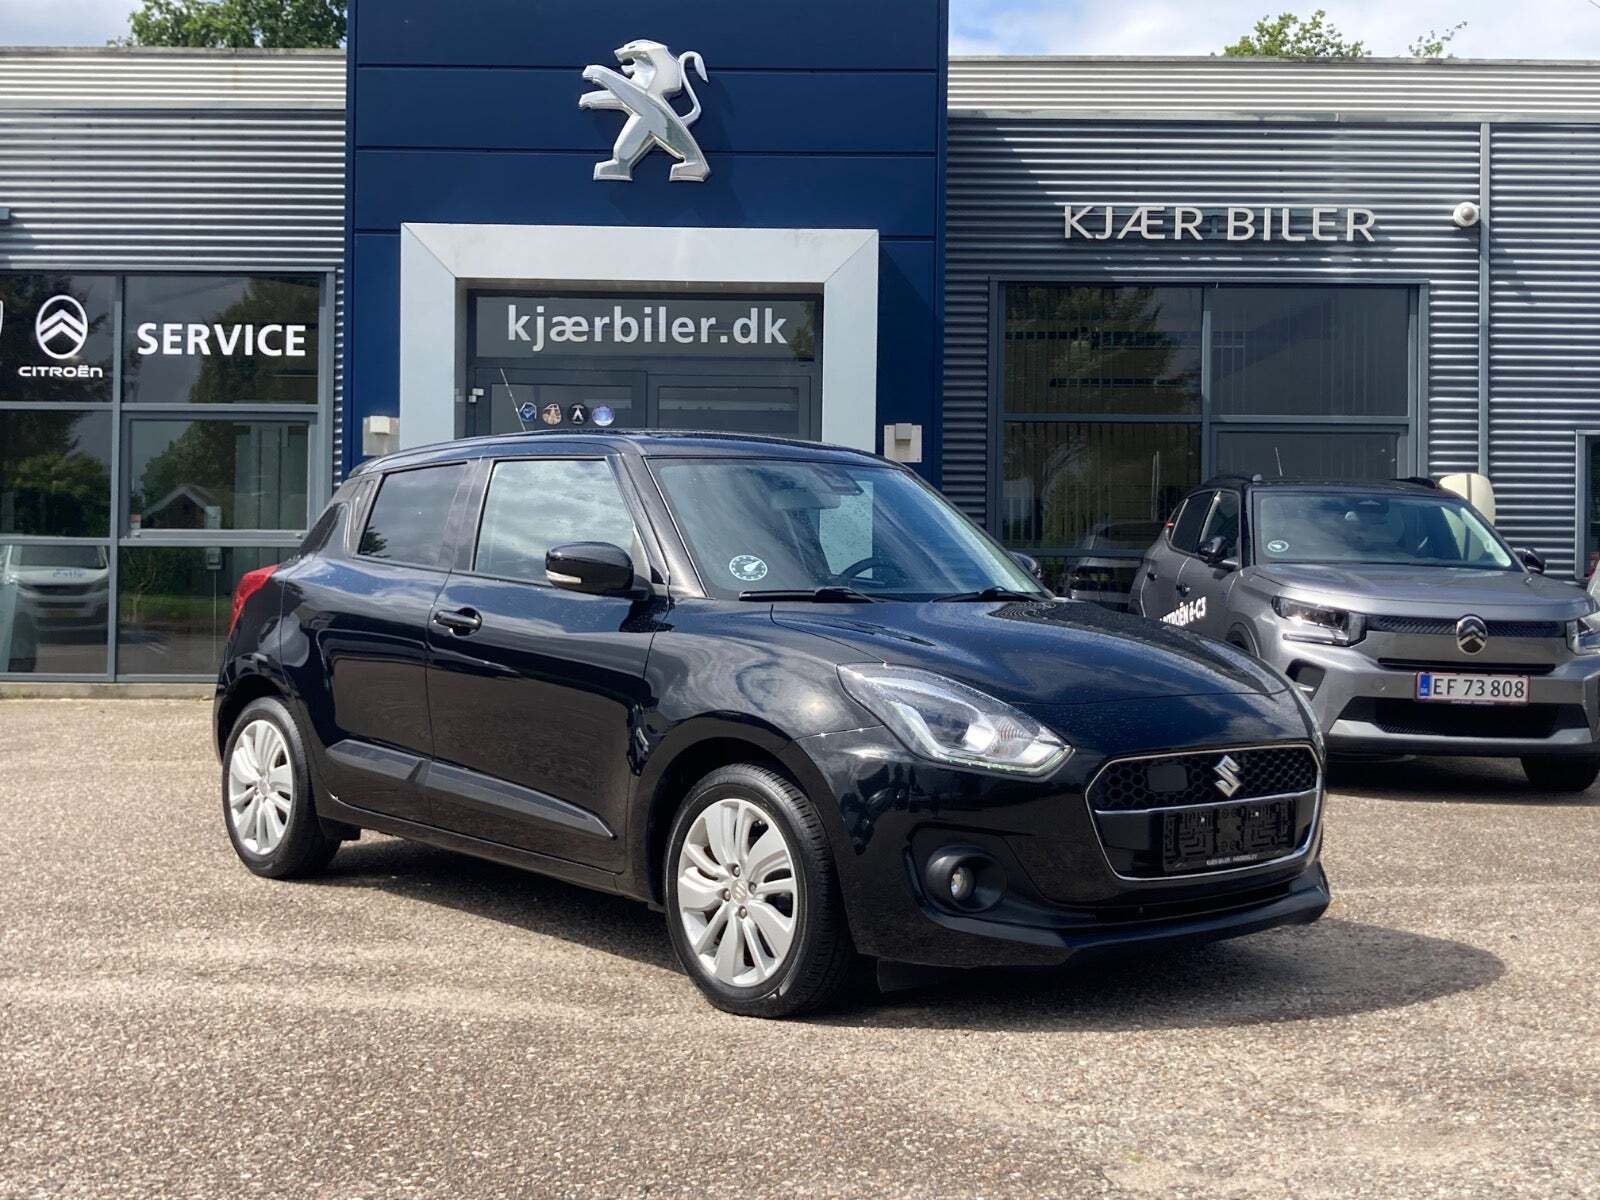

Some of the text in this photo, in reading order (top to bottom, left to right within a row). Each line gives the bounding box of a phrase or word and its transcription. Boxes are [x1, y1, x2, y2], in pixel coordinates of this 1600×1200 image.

[1063, 206, 1376, 242] KJÆR BILER
[137, 322, 306, 356] SERVICE
[507, 304, 788, 351] kjærbiler.dk
[1433, 678, 1457, 695] EF
[1463, 679, 1485, 696] 73
[1490, 680, 1525, 698] 808
